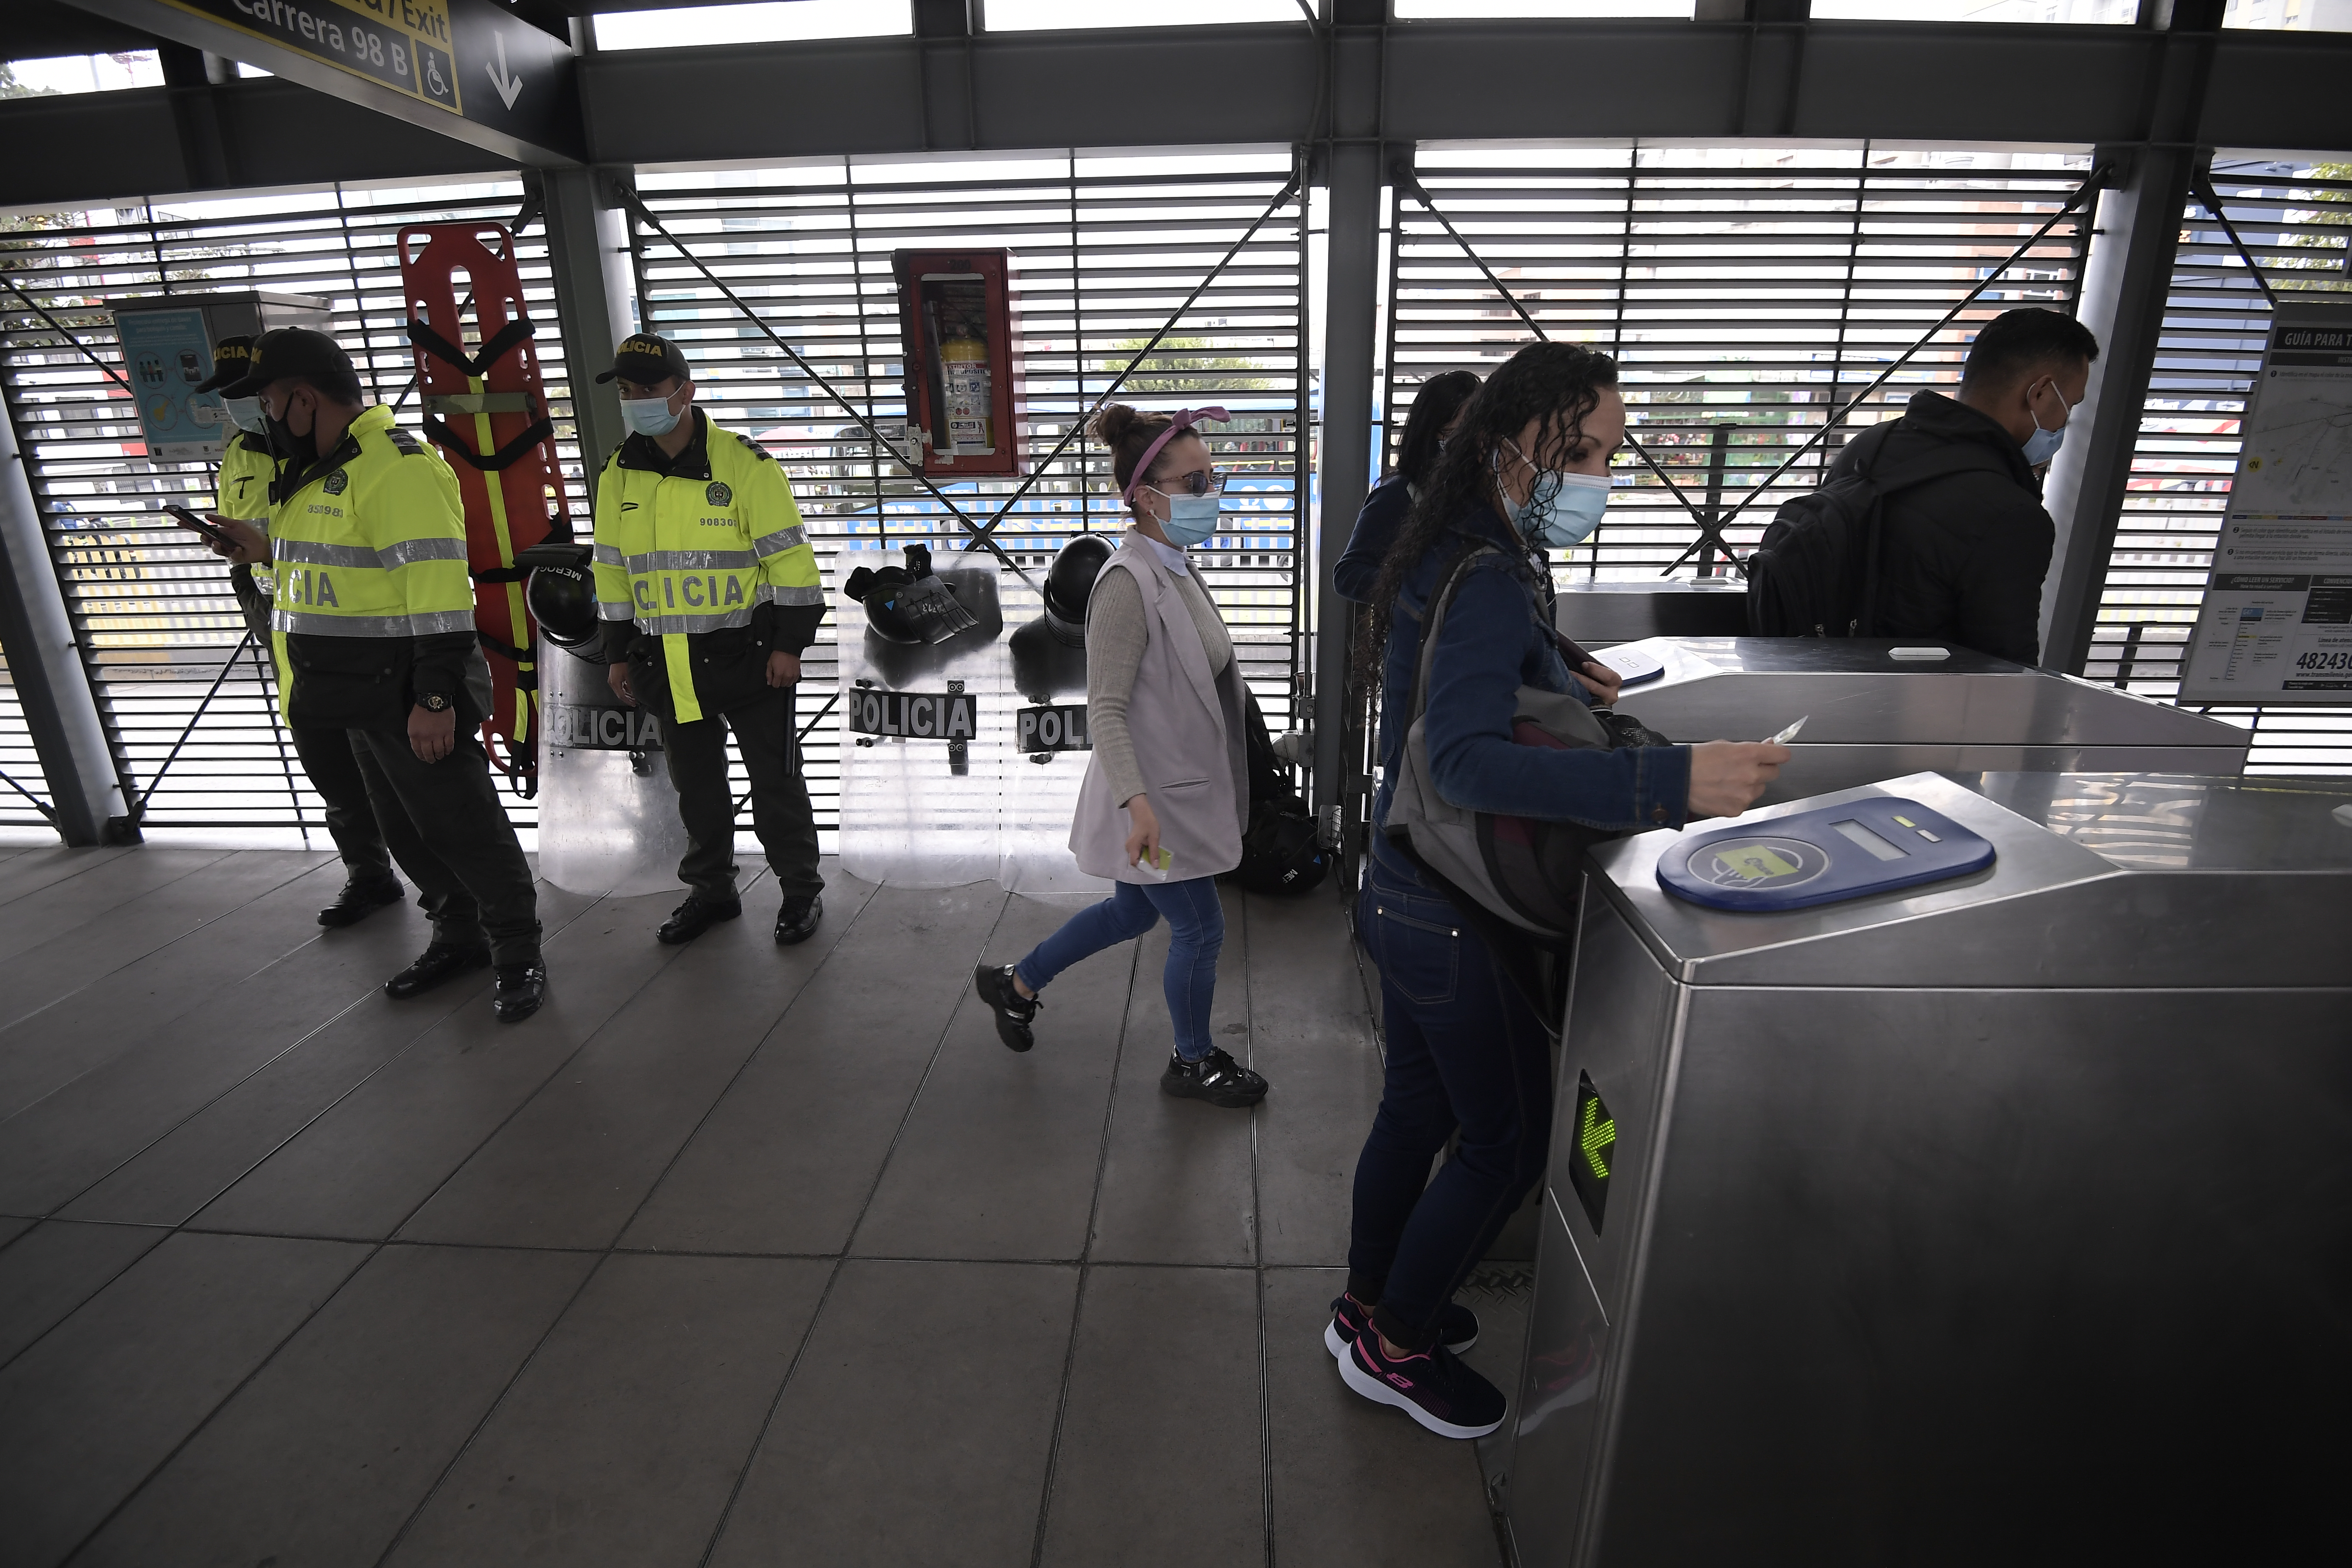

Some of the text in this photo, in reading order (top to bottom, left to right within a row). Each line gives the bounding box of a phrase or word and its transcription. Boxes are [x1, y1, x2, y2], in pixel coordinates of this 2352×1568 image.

[352, 27, 384, 67] 98
[391, 42, 408, 76] B
[2284, 331, 2311, 346] GUÍA
[2314, 333, 2343, 346] PARA
[544, 707, 662, 746] POLICIA
[850, 692, 973, 737] POLICIA
